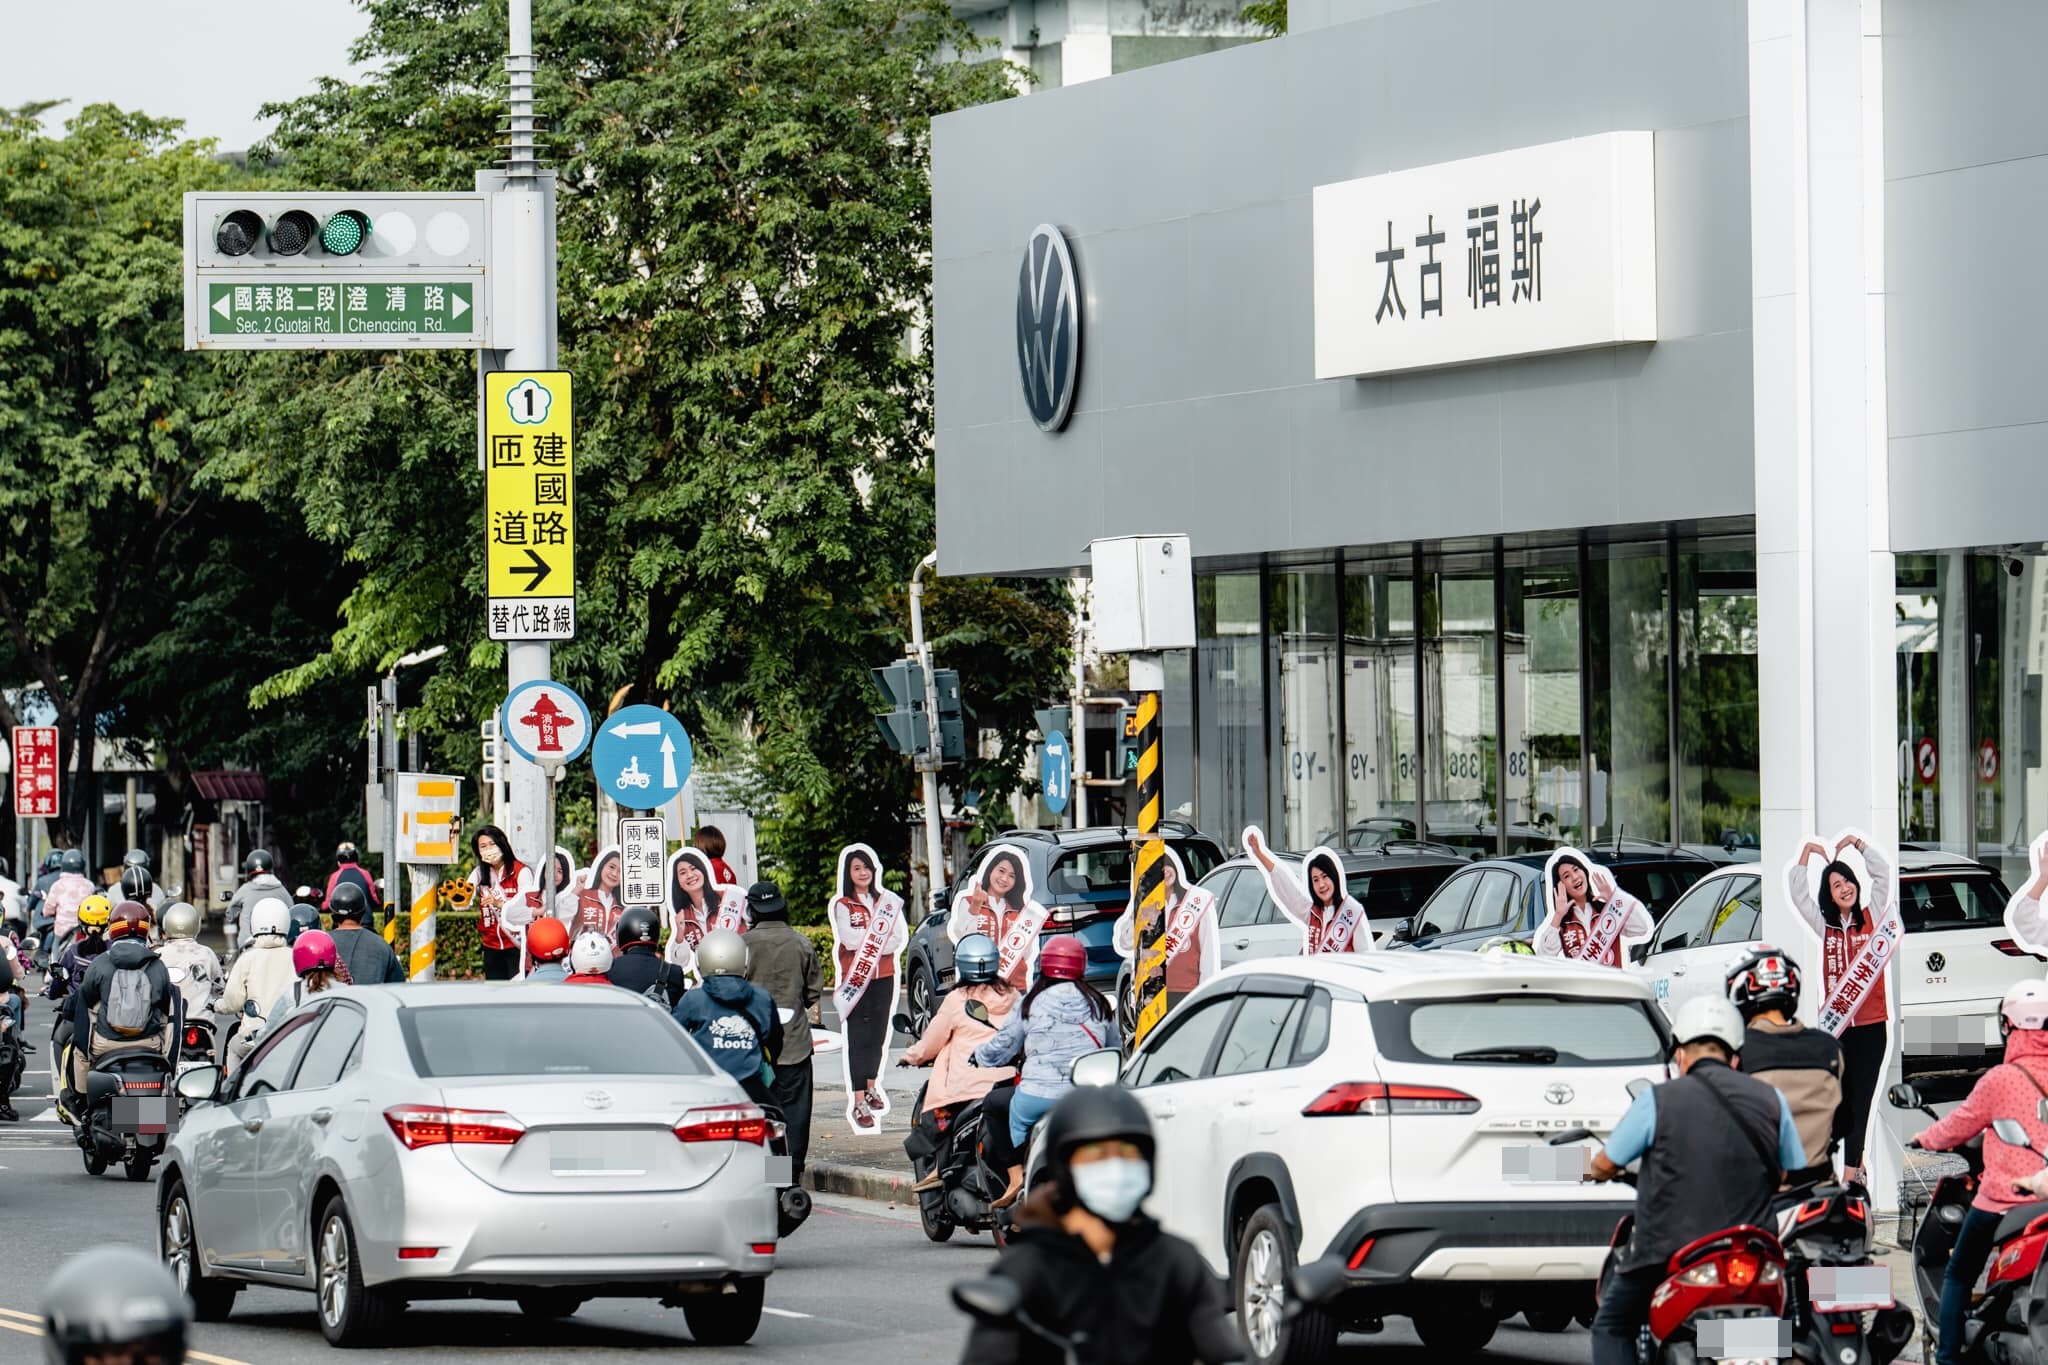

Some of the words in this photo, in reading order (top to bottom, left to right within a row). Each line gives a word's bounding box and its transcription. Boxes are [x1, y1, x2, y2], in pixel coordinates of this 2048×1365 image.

[1375, 197, 1543, 325] 太古福斯
[235, 286, 335, 312] 國泰路二段
[347, 286, 445, 312] 澄清路
[236, 317, 261, 333] Sec.
[264, 318, 271, 333] 2
[275, 316, 311, 333] Guotai
[315, 316, 334, 333] Rd.
[349, 317, 416, 334] Chengcing
[425, 317, 446, 332] Rd.
[524, 389, 533, 416] 1
[492, 434, 528, 545] 匝道
[532, 432, 567, 545] 建國路
[492, 604, 571, 634] 替代路線
[541, 713, 555, 745] 消防栓
[18, 730, 35, 813] 直行三多路
[35, 730, 53, 813] 禁止機車
[626, 824, 642, 899] 兩段左轉
[645, 824, 661, 898] 機慢車
[1877, 940, 1885, 952] 1
[1926, 976, 1948, 984] GTI
[713, 1037, 753, 1049] Roots
